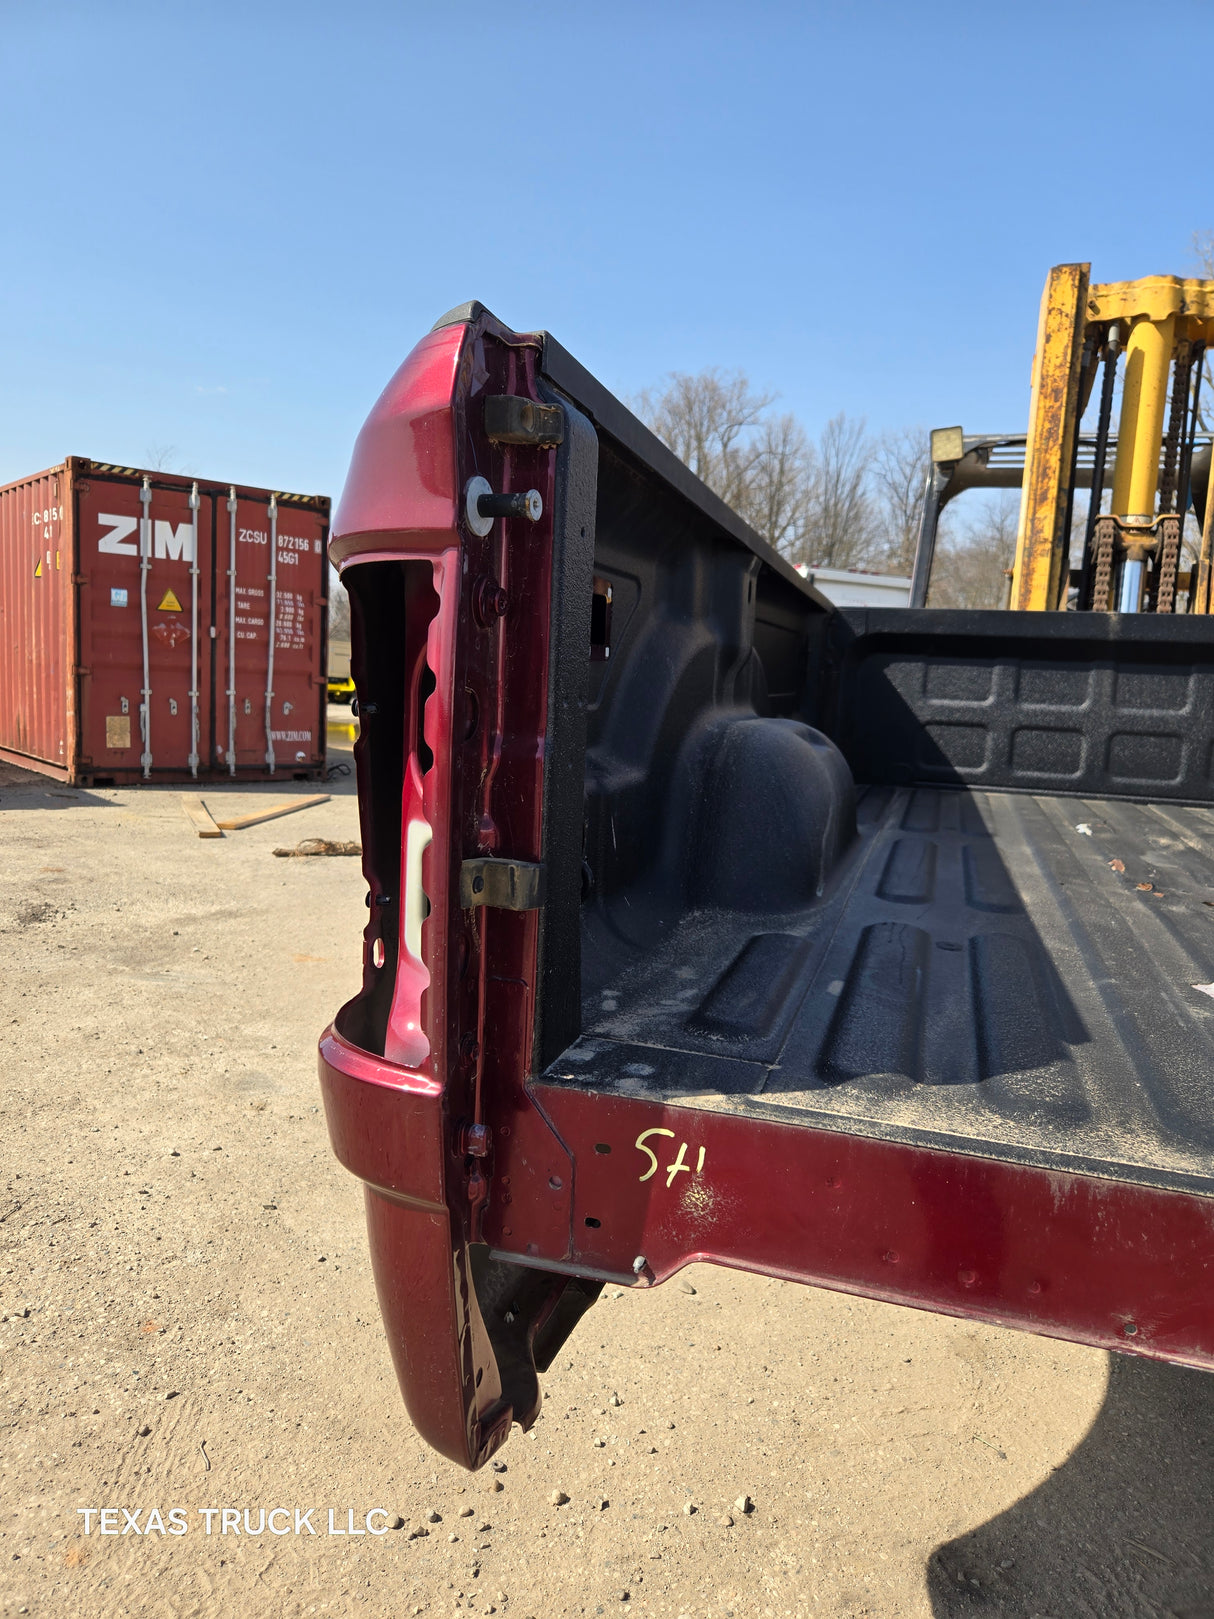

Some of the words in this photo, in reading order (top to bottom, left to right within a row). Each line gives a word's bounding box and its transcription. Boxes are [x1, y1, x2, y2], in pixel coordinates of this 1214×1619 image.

[98, 512, 194, 562] ZIM
[239, 528, 268, 545] ZCSU
[278, 535, 309, 551] 872156
[278, 551, 299, 565] 45G1
